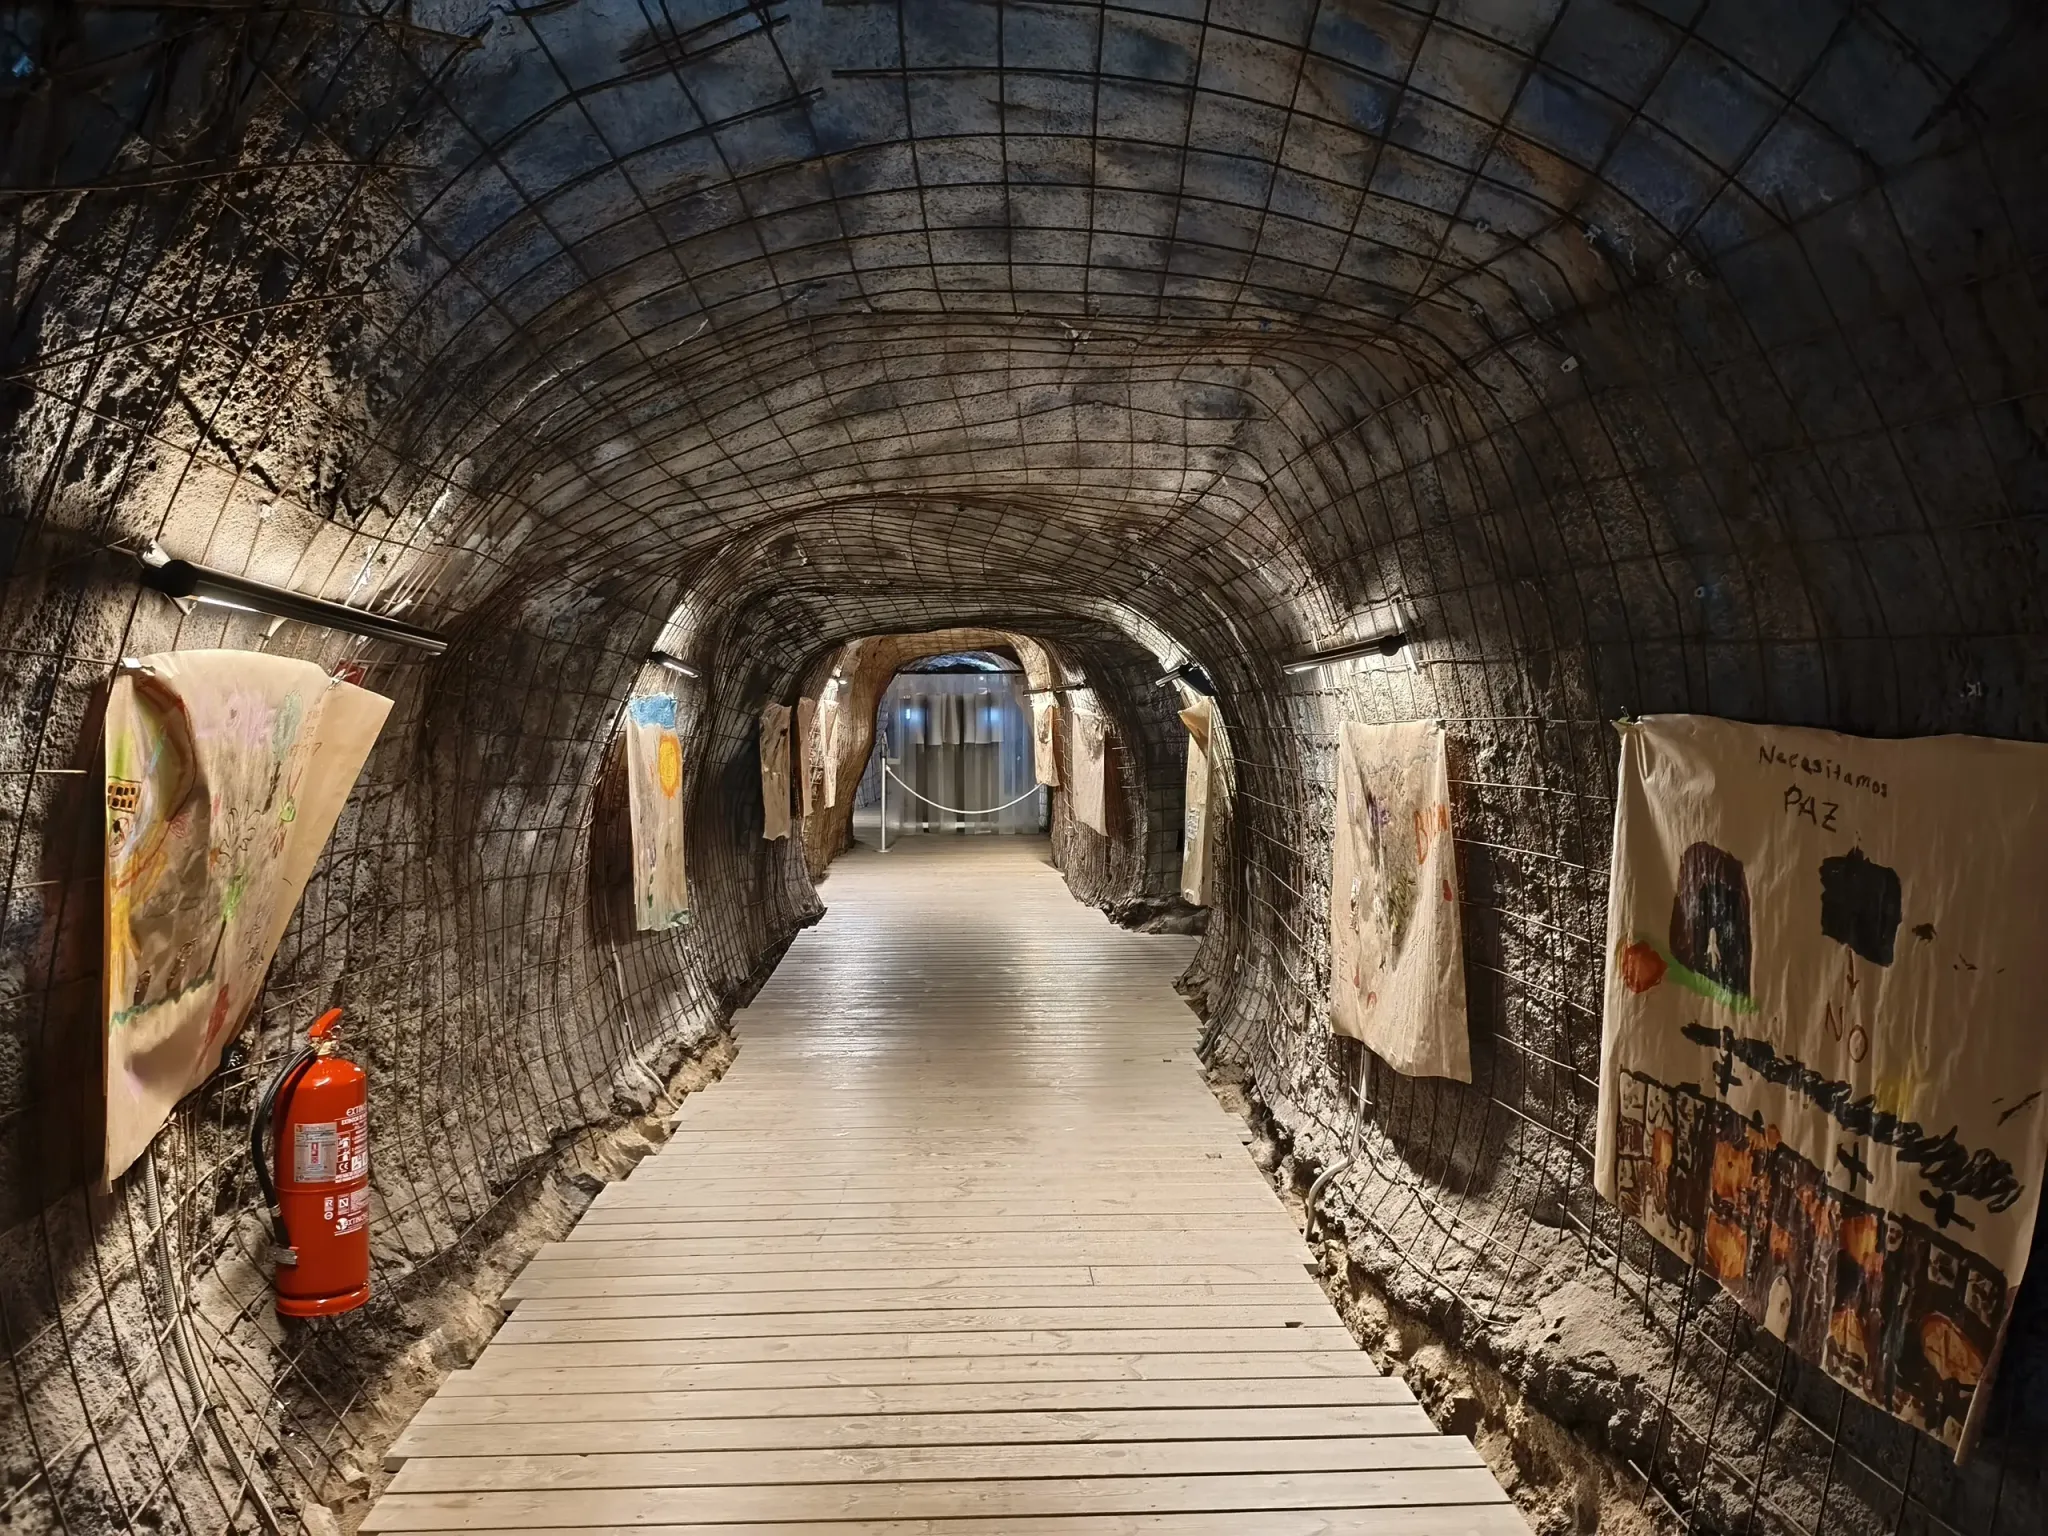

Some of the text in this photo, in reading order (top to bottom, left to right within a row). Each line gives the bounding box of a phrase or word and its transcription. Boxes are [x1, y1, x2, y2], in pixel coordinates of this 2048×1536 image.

[1758, 745, 1888, 798] Necesitamos
[1784, 783, 1839, 833] PAZ
[1824, 1000, 1868, 1064] NO
